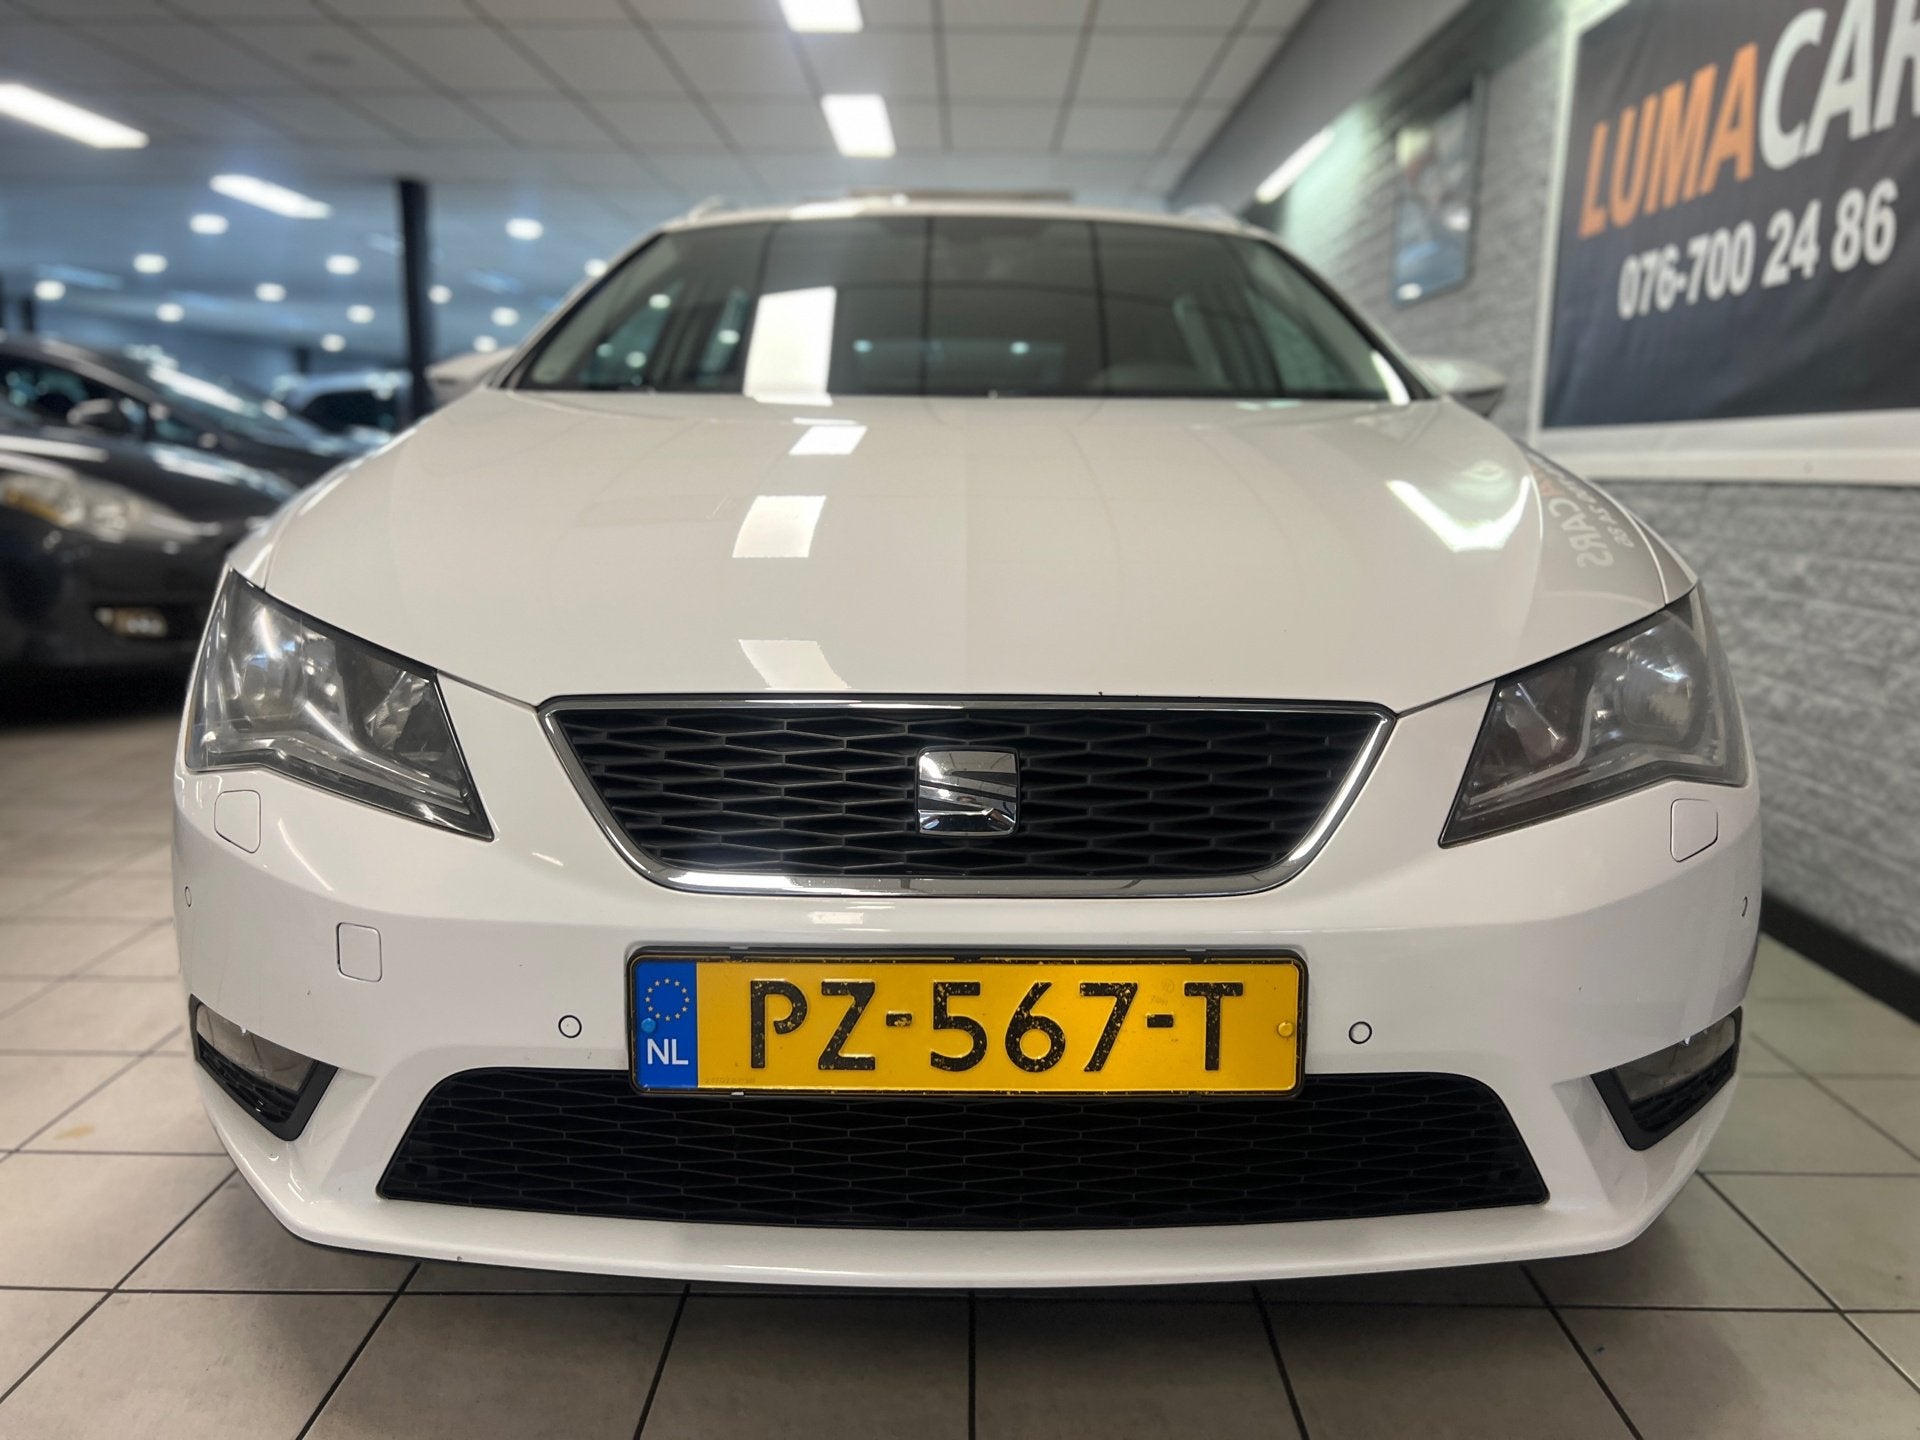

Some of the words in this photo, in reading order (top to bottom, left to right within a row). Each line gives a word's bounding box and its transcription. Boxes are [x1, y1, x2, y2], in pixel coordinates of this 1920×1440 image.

[1617, 220, 1756, 320] 076-700
[1761, 199, 1822, 288] 24
[1831, 178, 1898, 272] 86
[646, 1038, 689, 1066] NL
[750, 981, 1244, 1073] PZ-567-T
